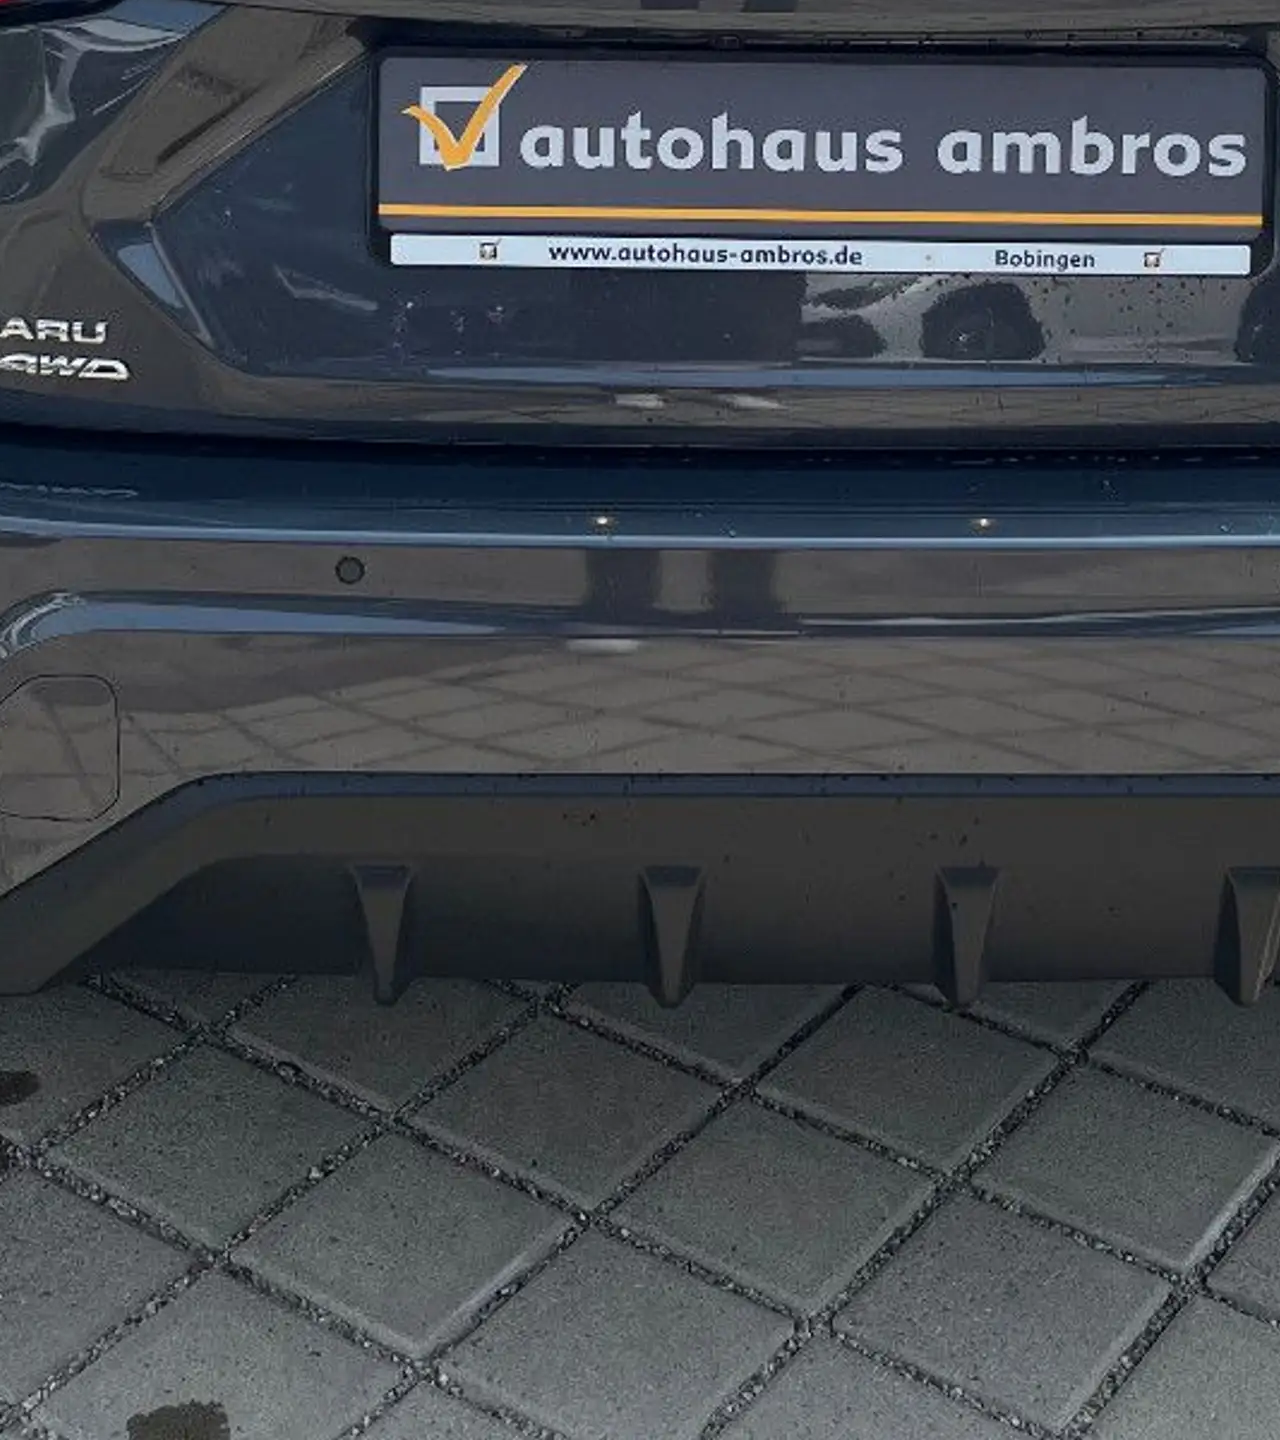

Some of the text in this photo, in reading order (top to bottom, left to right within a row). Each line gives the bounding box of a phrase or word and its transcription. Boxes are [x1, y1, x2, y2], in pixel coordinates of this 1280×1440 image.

[520, 111, 1247, 177] autohaus ambros
[548, 242, 862, 266] www.autohaus-ambros.de
[995, 249, 1096, 272] Bobingen
